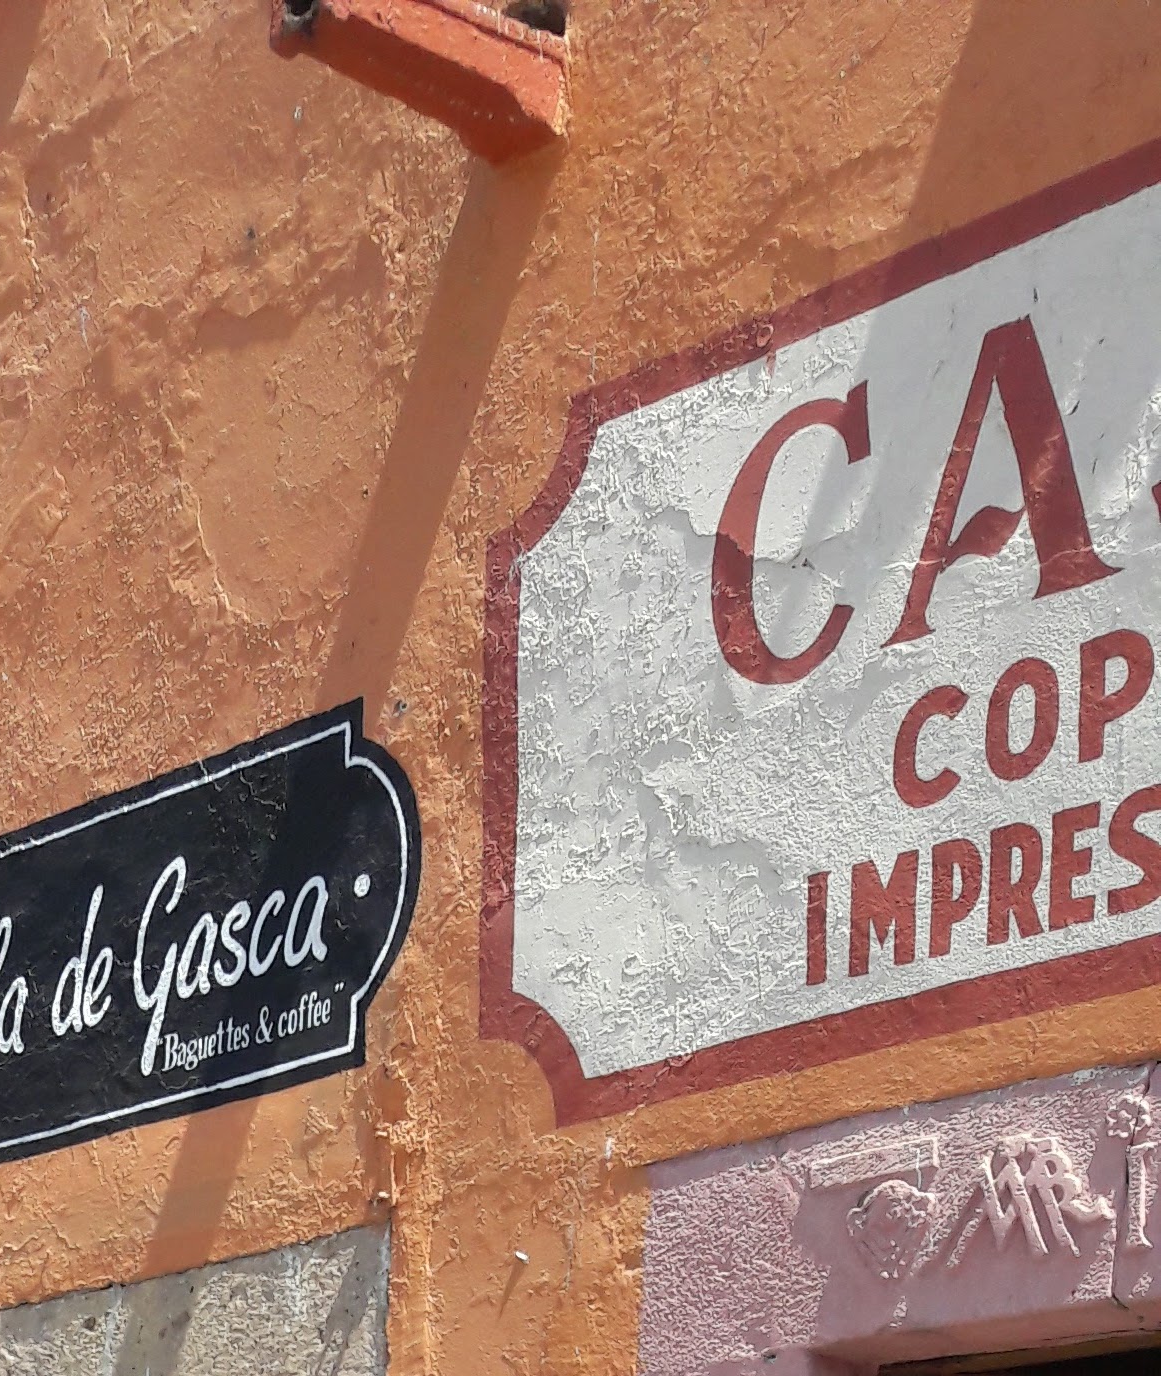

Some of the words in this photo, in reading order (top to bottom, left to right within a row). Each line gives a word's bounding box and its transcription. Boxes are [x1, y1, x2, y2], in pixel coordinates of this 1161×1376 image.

[711, 313, 1161, 686] CA
[892, 628, 1154, 809] COP
[51, 884, 113, 1036] de
[133, 857, 330, 1077] Gasca
[806, 783, 1161, 987] IMPRES
[255, 1005, 274, 1044] &
